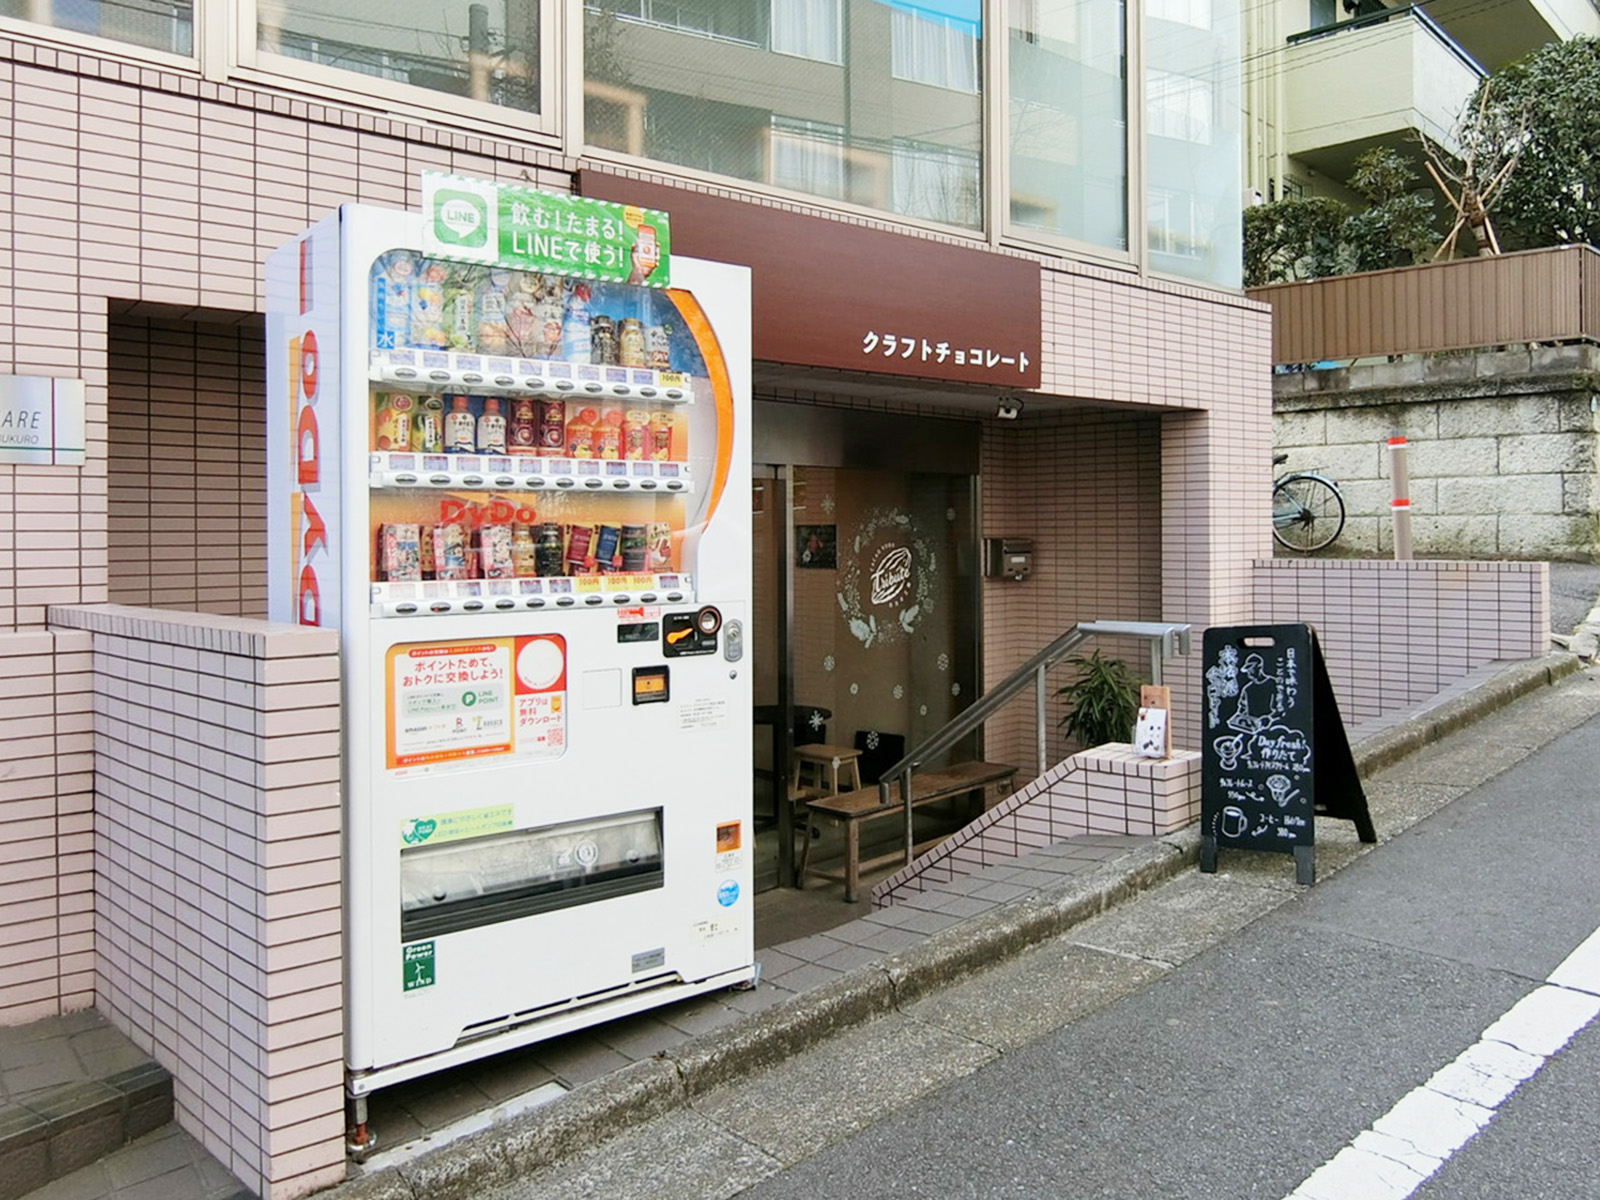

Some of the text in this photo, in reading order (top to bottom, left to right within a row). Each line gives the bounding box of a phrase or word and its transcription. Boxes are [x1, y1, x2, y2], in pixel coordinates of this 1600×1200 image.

[447, 209, 475, 224] LINE
[377, 333, 394, 348] 水
[862, 331, 1029, 373] クラフトチョコレート
[440, 500, 536, 530] DyDo
[477, 690, 493, 698] LINE
[478, 696, 499, 704] POINT
[519, 715, 562, 727] ダウンロード
[406, 944, 432, 954] Green
[405, 950, 433, 961] Power
